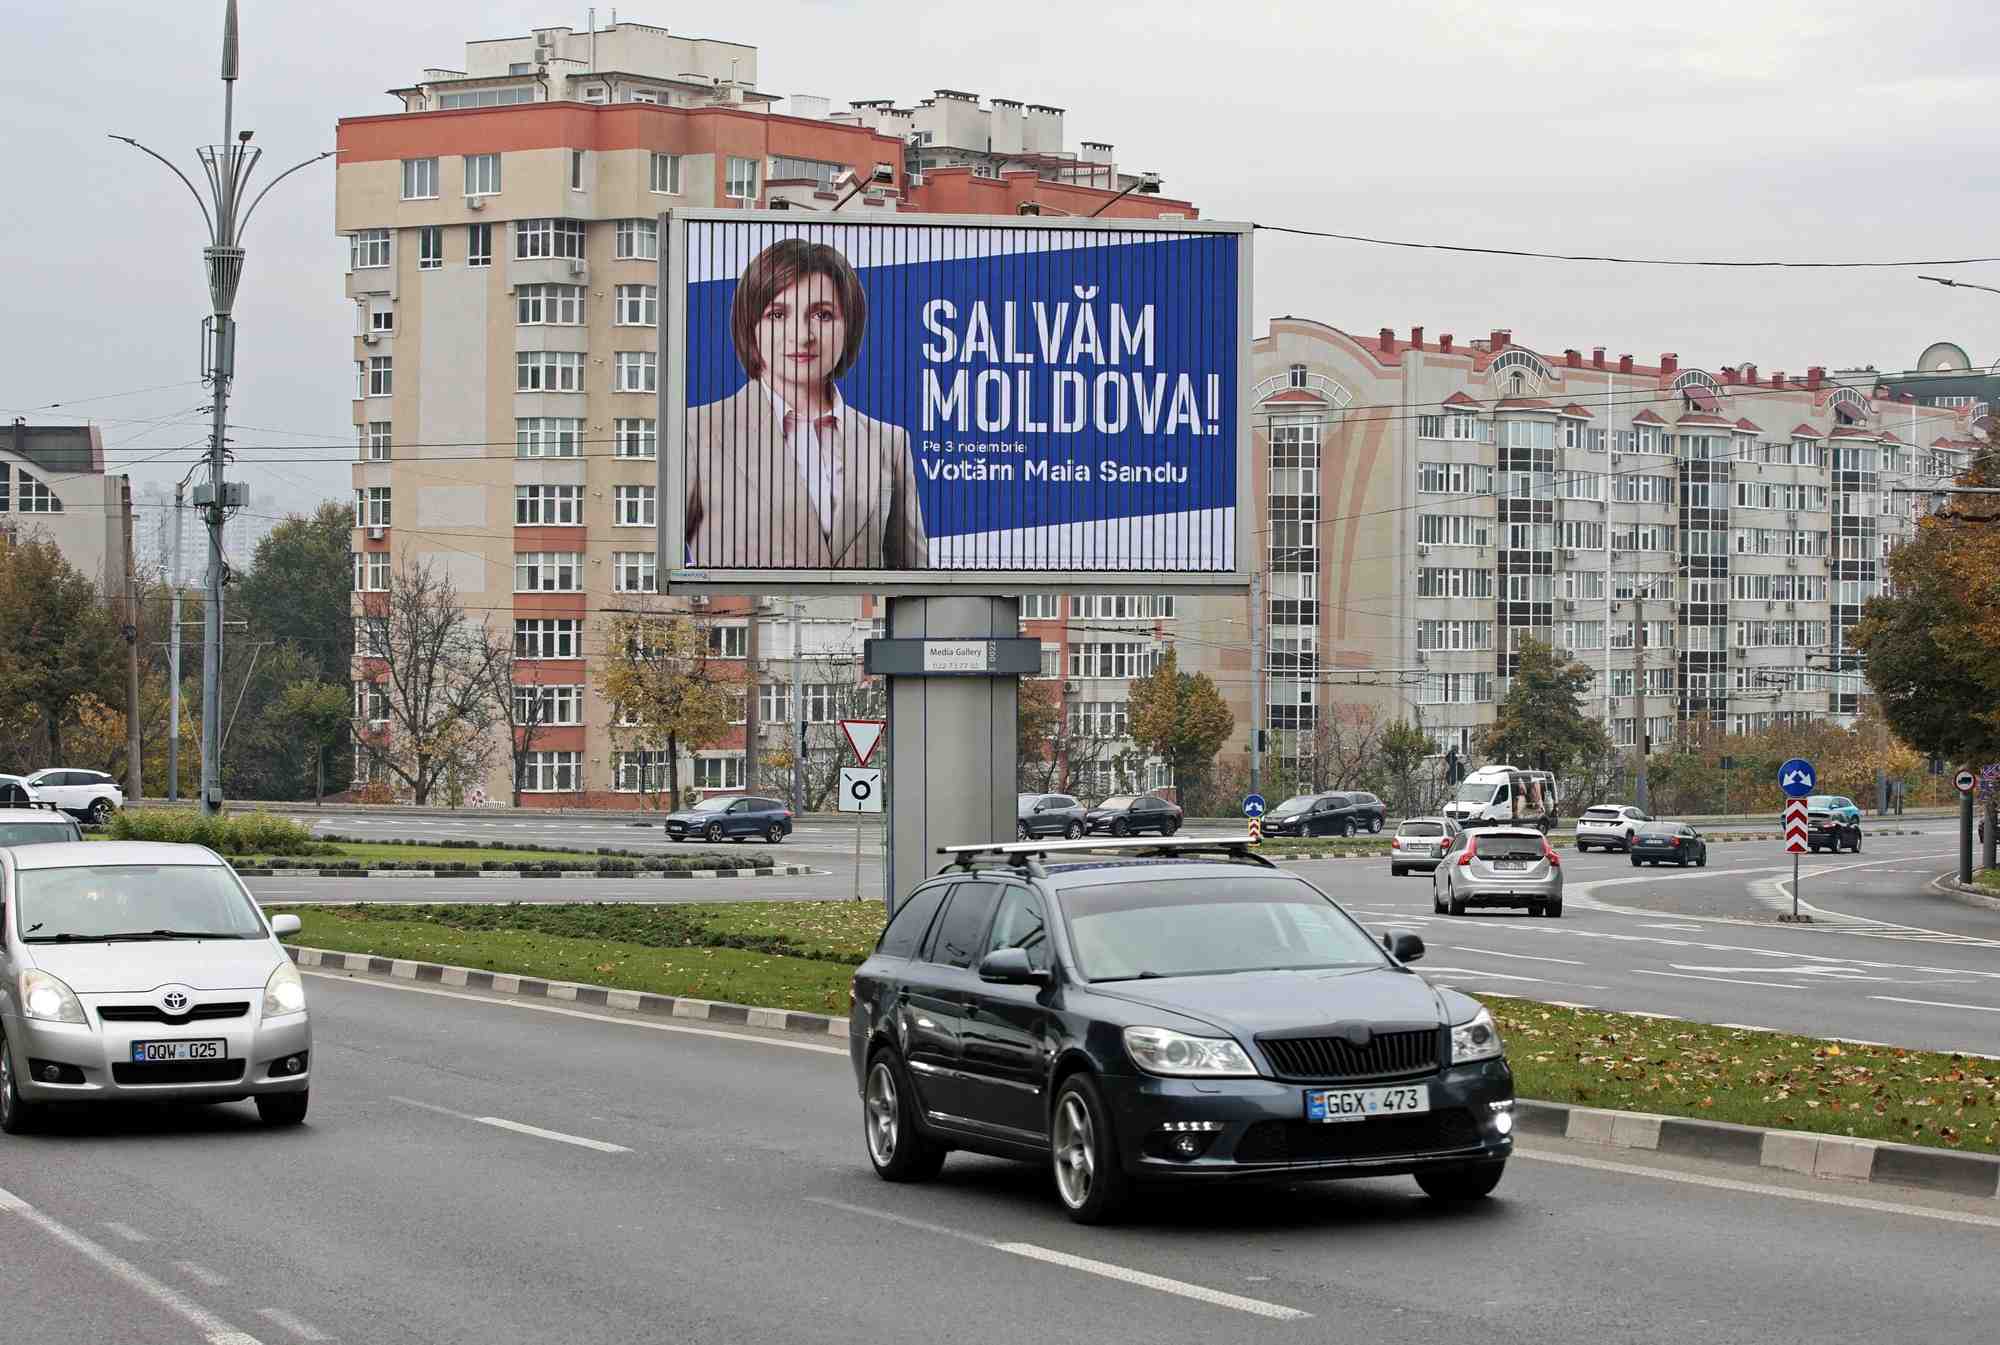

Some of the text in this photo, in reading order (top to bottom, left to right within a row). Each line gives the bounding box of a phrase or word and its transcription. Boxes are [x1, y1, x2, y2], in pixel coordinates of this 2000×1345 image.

[922, 285, 1155, 366] SALVĂM
[922, 368, 1219, 435] MOLDOVA!
[922, 441, 1026, 453] Pe 3 noiembrie
[921, 459, 1188, 484] Votăm Maia Sandu
[929, 648, 983, 658] Media Gallery
[147, 1044, 176, 1060] QQW
[189, 1042, 217, 1058] 025
[1327, 1089, 1418, 1114] GGX 473
